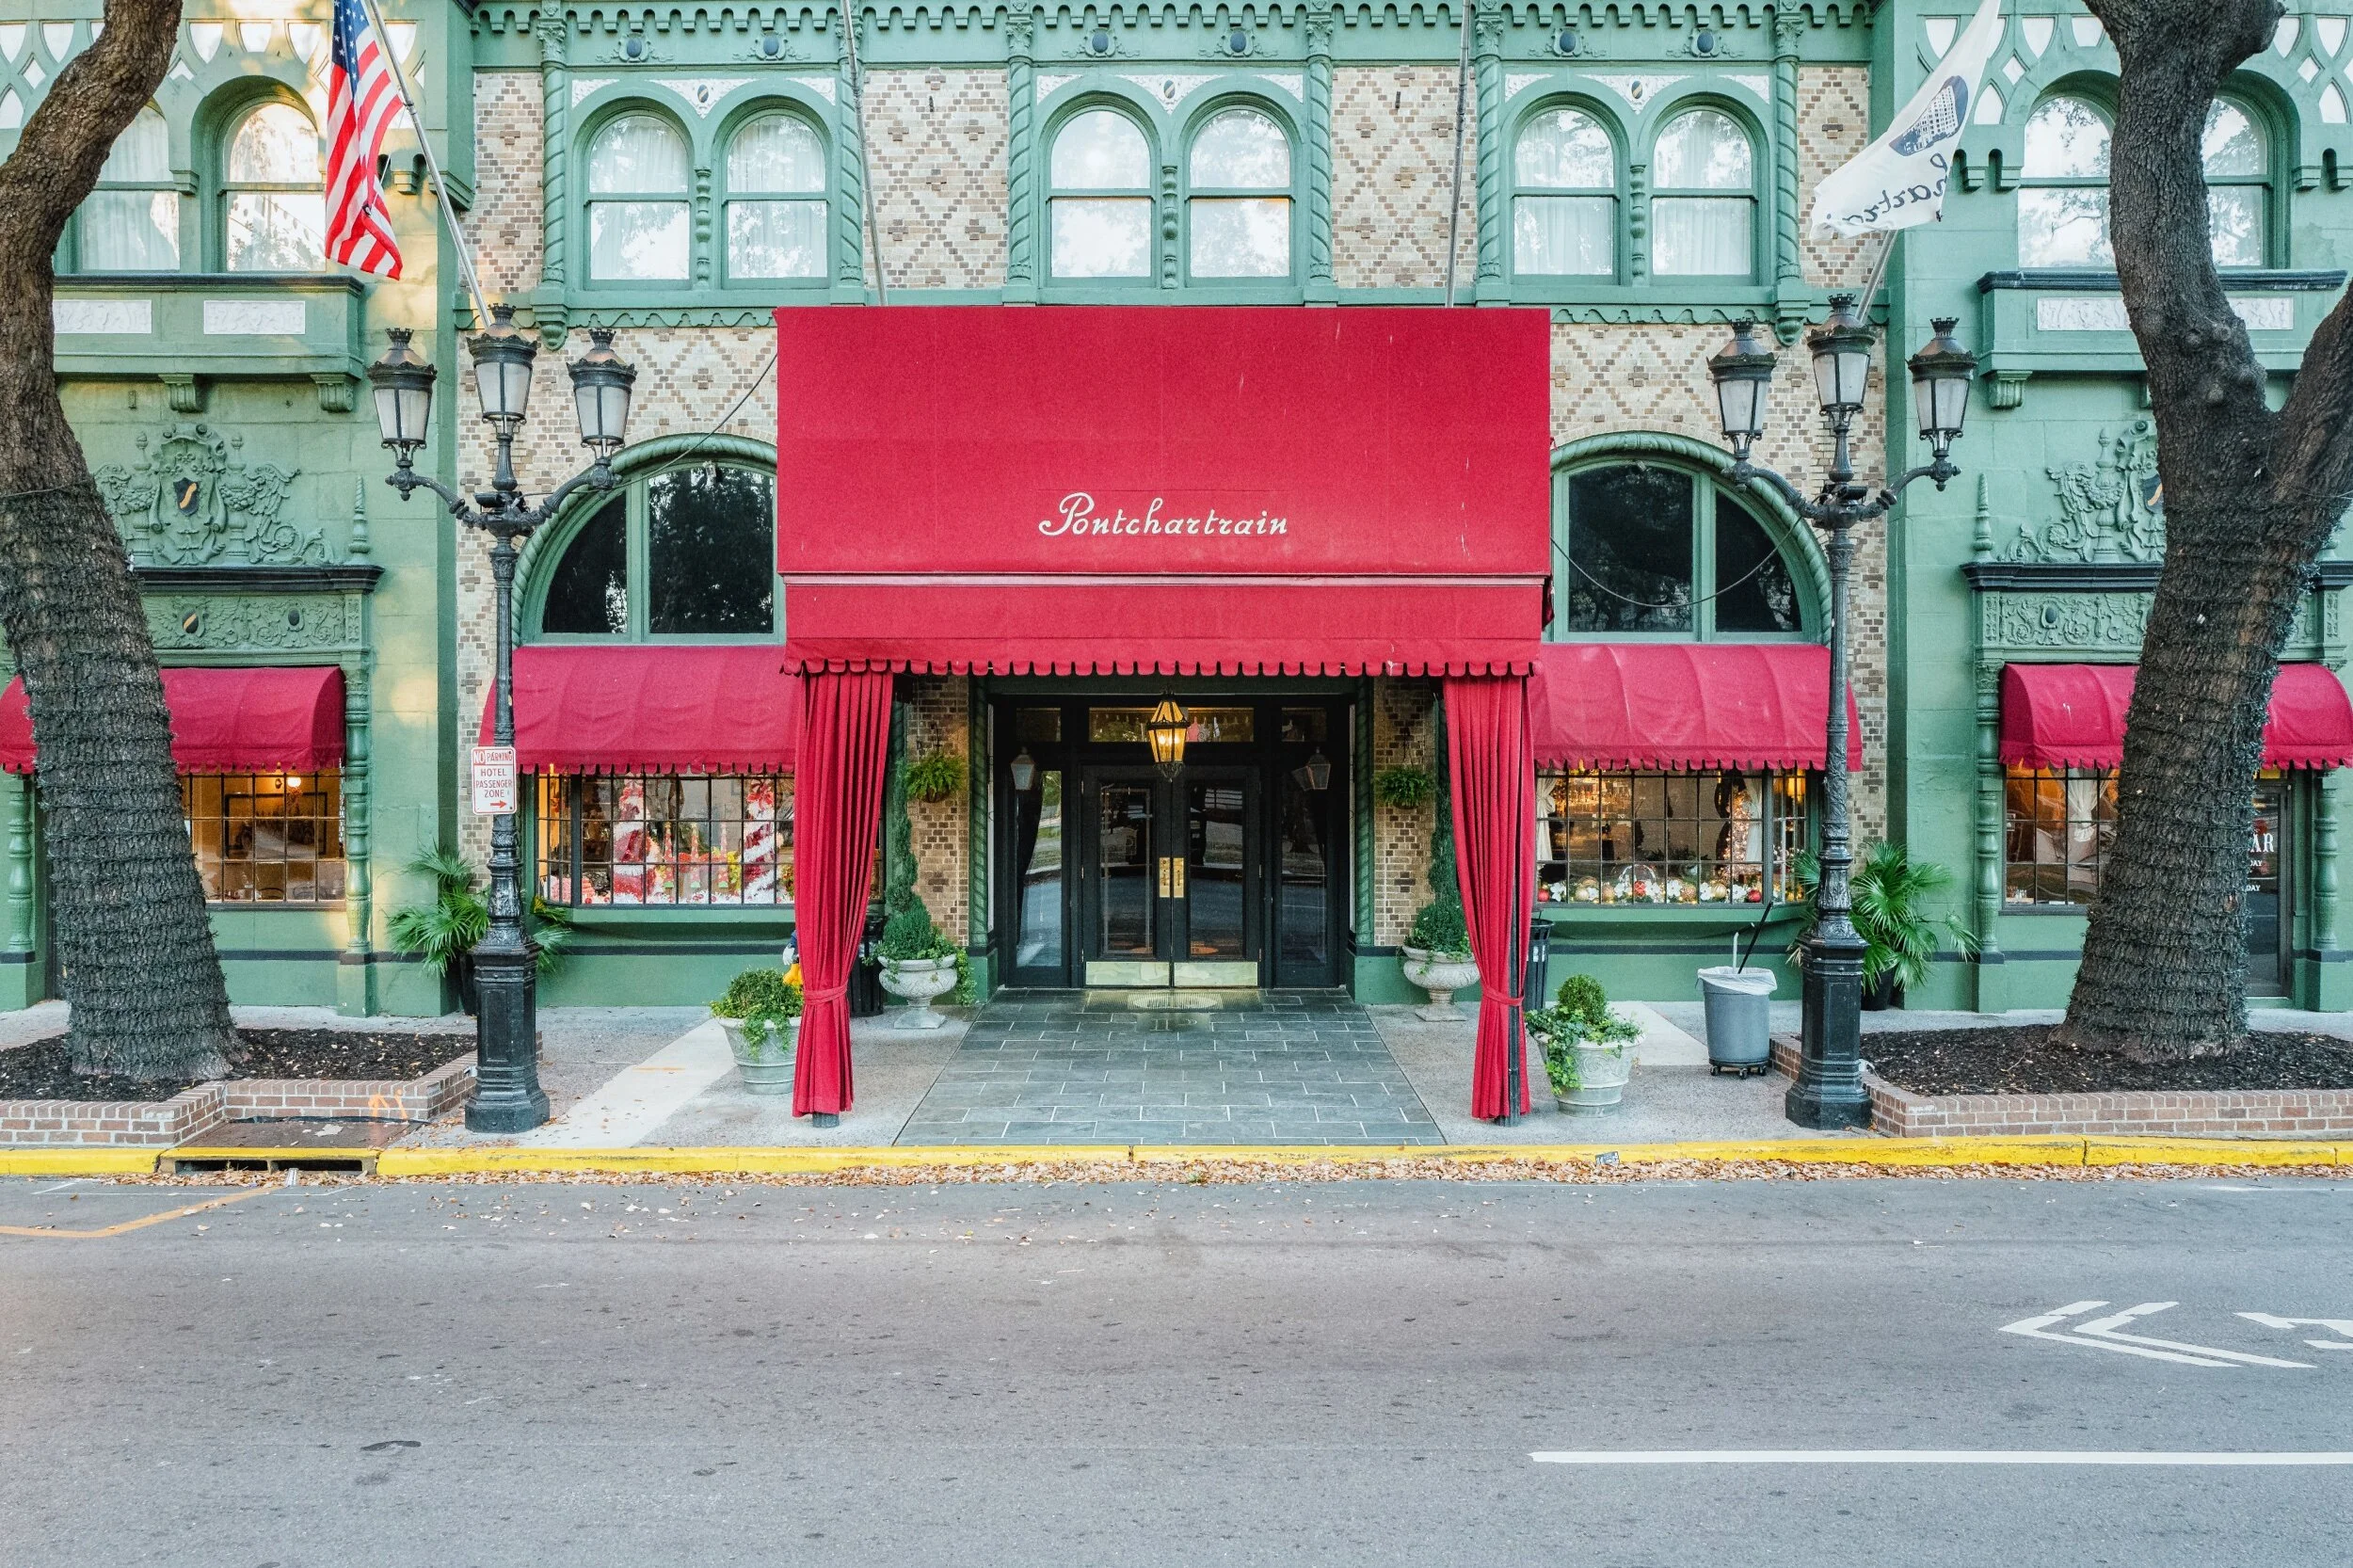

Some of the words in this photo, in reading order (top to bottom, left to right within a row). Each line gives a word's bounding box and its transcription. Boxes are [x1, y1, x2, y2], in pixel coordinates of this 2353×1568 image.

[1038, 491, 1288, 536] Pontchartrain
[473, 751, 486, 763] NO
[487, 752, 512, 761] PARKING
[480, 768, 507, 776] HOTEL
[476, 780, 512, 789] PASSENGER
[484, 790, 504, 798] ZONE
